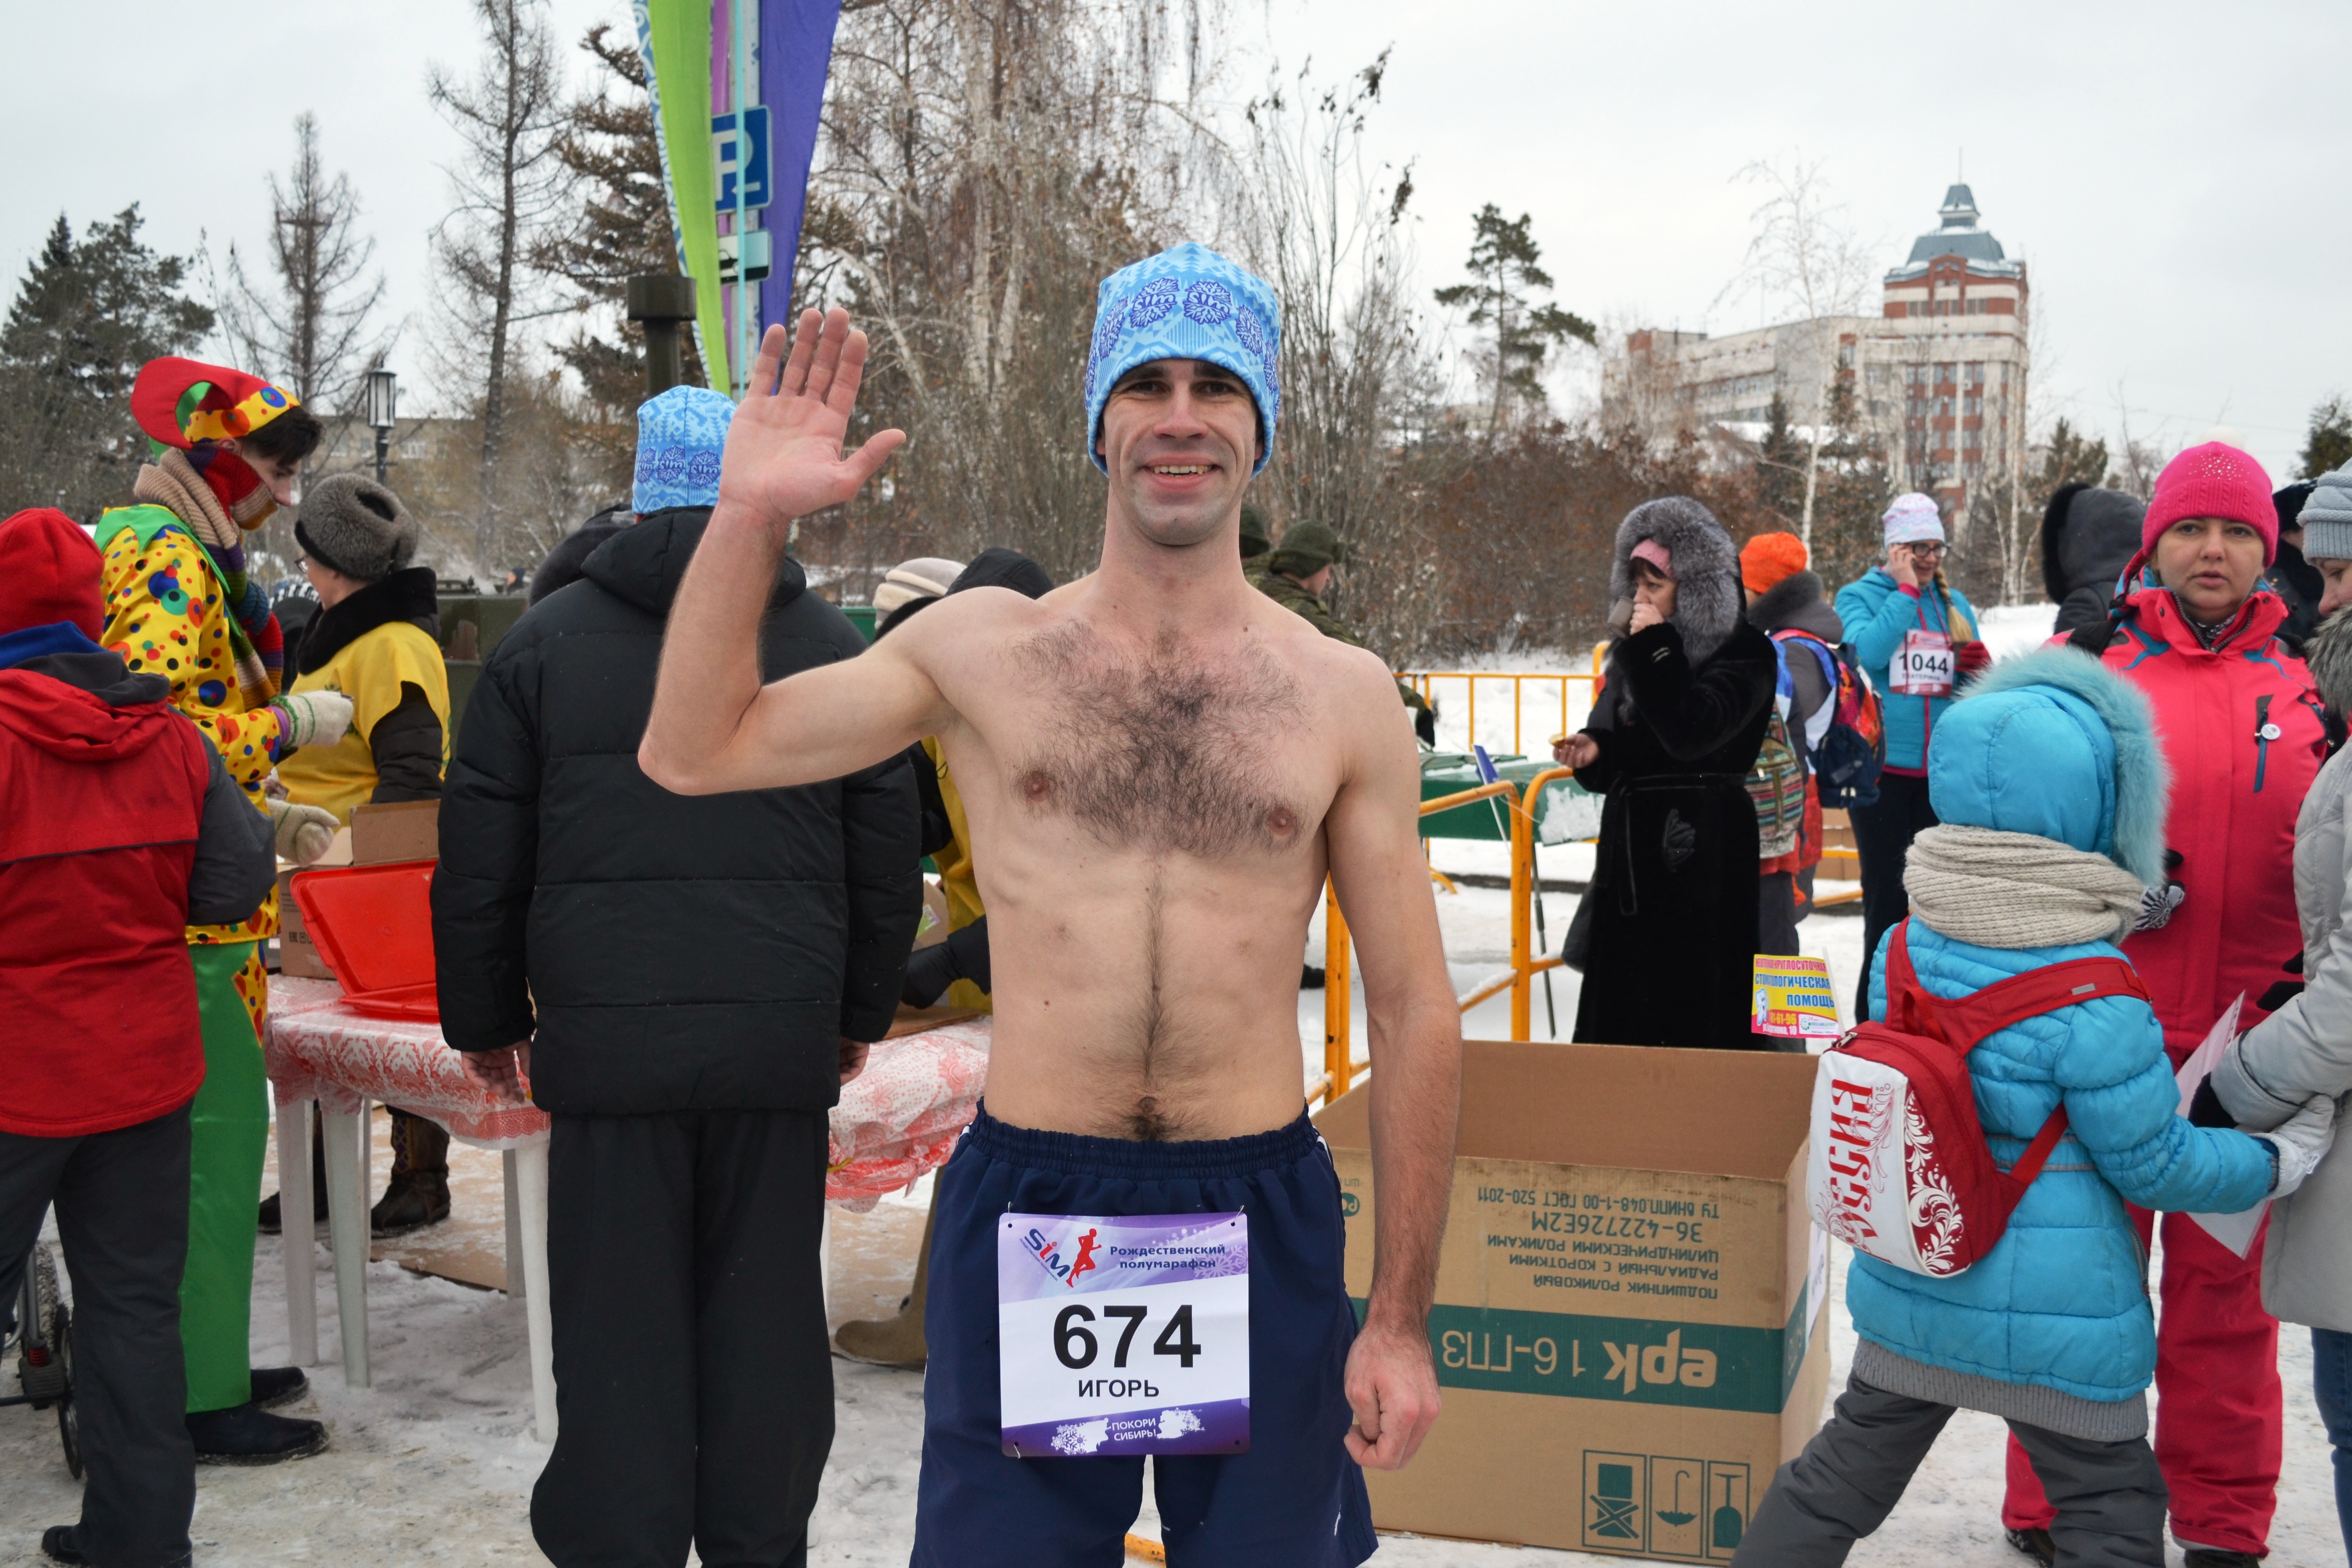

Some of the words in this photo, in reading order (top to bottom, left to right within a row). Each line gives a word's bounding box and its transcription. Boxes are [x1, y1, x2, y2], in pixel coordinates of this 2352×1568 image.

[1898, 654, 1948, 675] 1044
[1787, 994, 1835, 1009] ПОМОЩЬ
[1478, 1187, 1535, 1205] 520-2011
[1542, 1192, 1577, 1209] ГОСТ
[1110, 1244, 1226, 1257] Рождественский
[1487, 1234, 1565, 1252] РОЛИКАМИ
[1573, 1241, 1719, 1263] ЦИЛИНДРИЧЕСКИМИ
[1120, 1259, 1216, 1270] полумарафон
[1509, 1254, 1596, 1271] КОРОТКИМИ
[1603, 1260, 1611, 1272] С
[1619, 1262, 1718, 1281] РАДИАЛЬНЫЙ
[1533, 1275, 1620, 1292] РОЛИКОВЫЙ
[1627, 1283, 1718, 1300] ПОДШИПНИК
[1054, 1304, 1202, 1369] 674
[1603, 1328, 1718, 1395] epk
[1078, 1379, 1160, 1398] ИГОРЬ
[1112, 1417, 1156, 1431] ПОКОРИ
[1114, 1428, 1157, 1441] СИБИРЬ!
